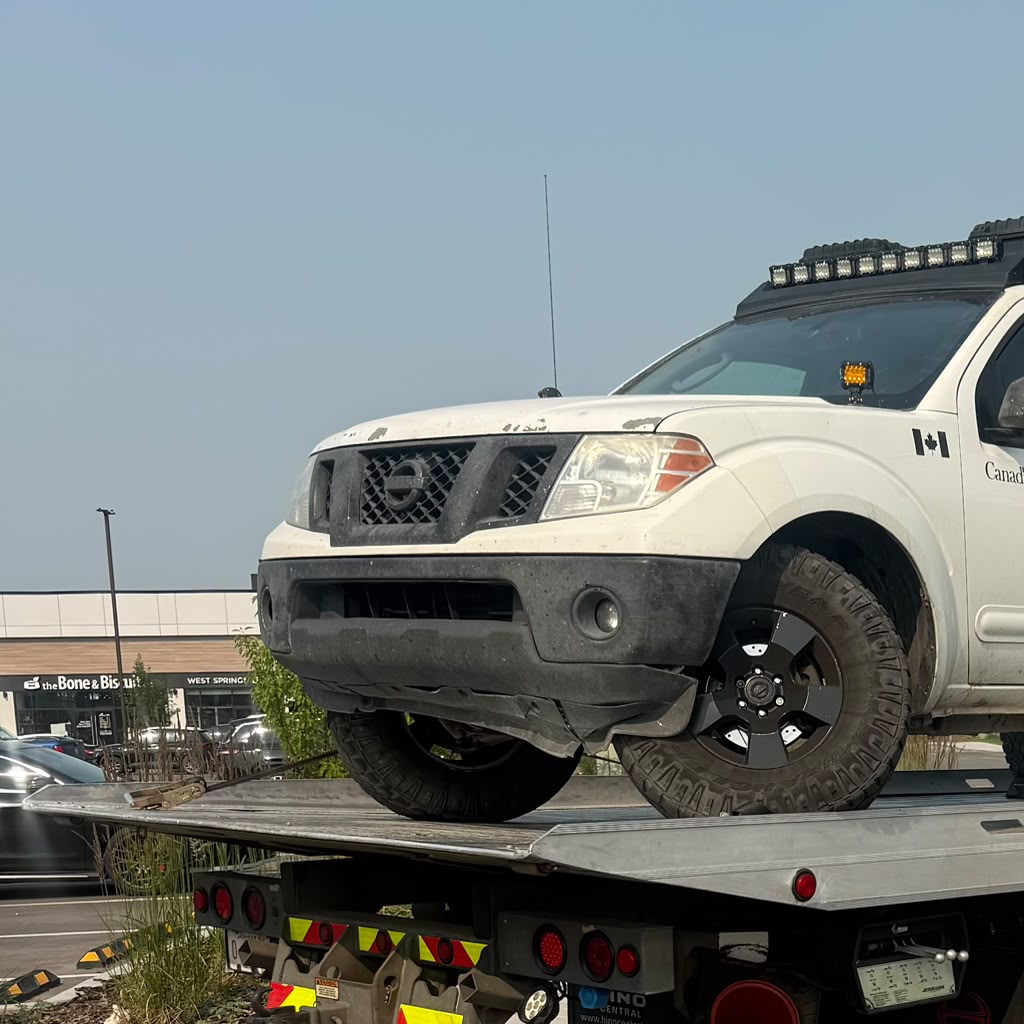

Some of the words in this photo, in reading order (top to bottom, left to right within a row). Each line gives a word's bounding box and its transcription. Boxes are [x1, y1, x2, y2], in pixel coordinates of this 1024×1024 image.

[58, 675, 91, 690] Bone
[91, 679, 100, 689] &
[100, 674, 142, 690] Bisuit
[609, 990, 646, 1008] INO
[600, 1004, 642, 1019] CENTRAL
